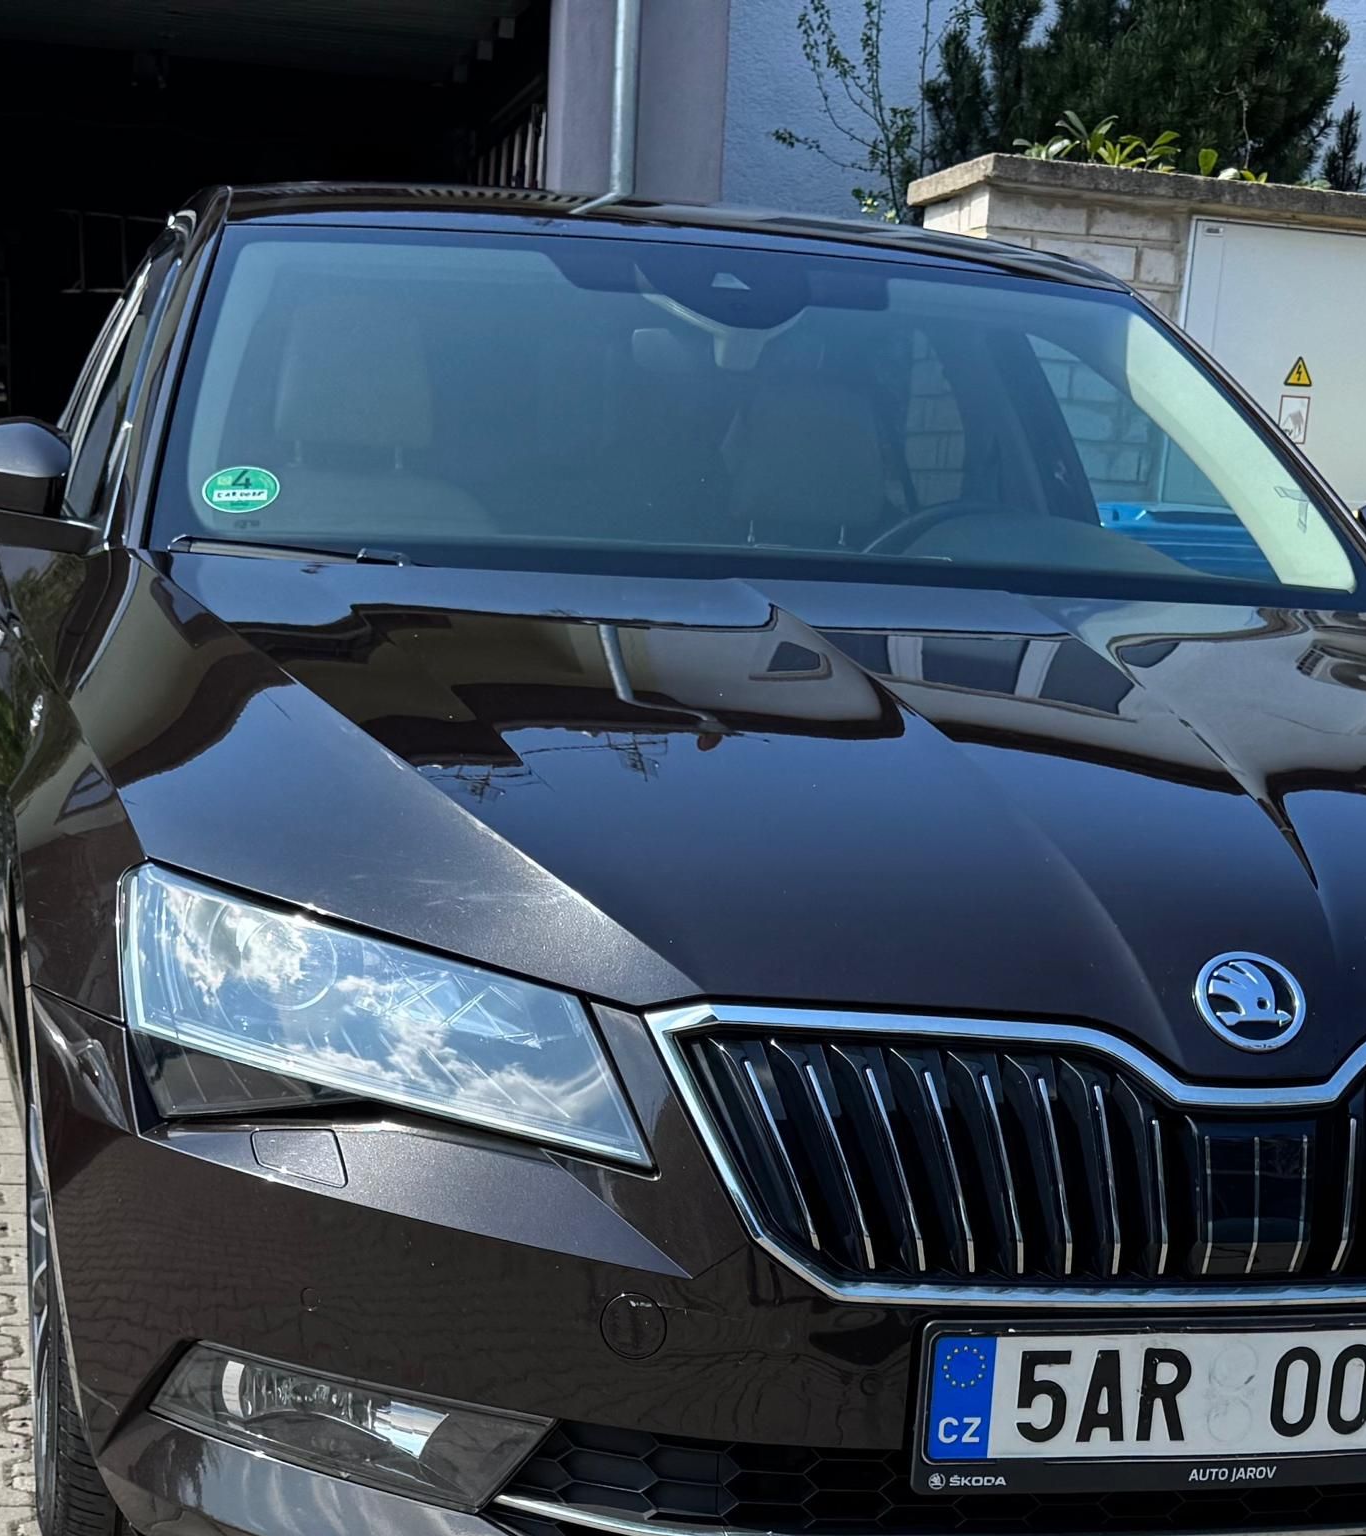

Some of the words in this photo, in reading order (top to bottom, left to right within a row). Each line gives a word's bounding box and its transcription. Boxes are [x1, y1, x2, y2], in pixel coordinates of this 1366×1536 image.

[231, 469, 252, 489] 4
[1015, 1347, 1192, 1443] 5AR
[937, 1417, 981, 1444] CZ
[949, 1474, 1007, 1487] ŠKODA
[1188, 1468, 1229, 1482] AUTO
[1230, 1466, 1277, 1483] JAROV
